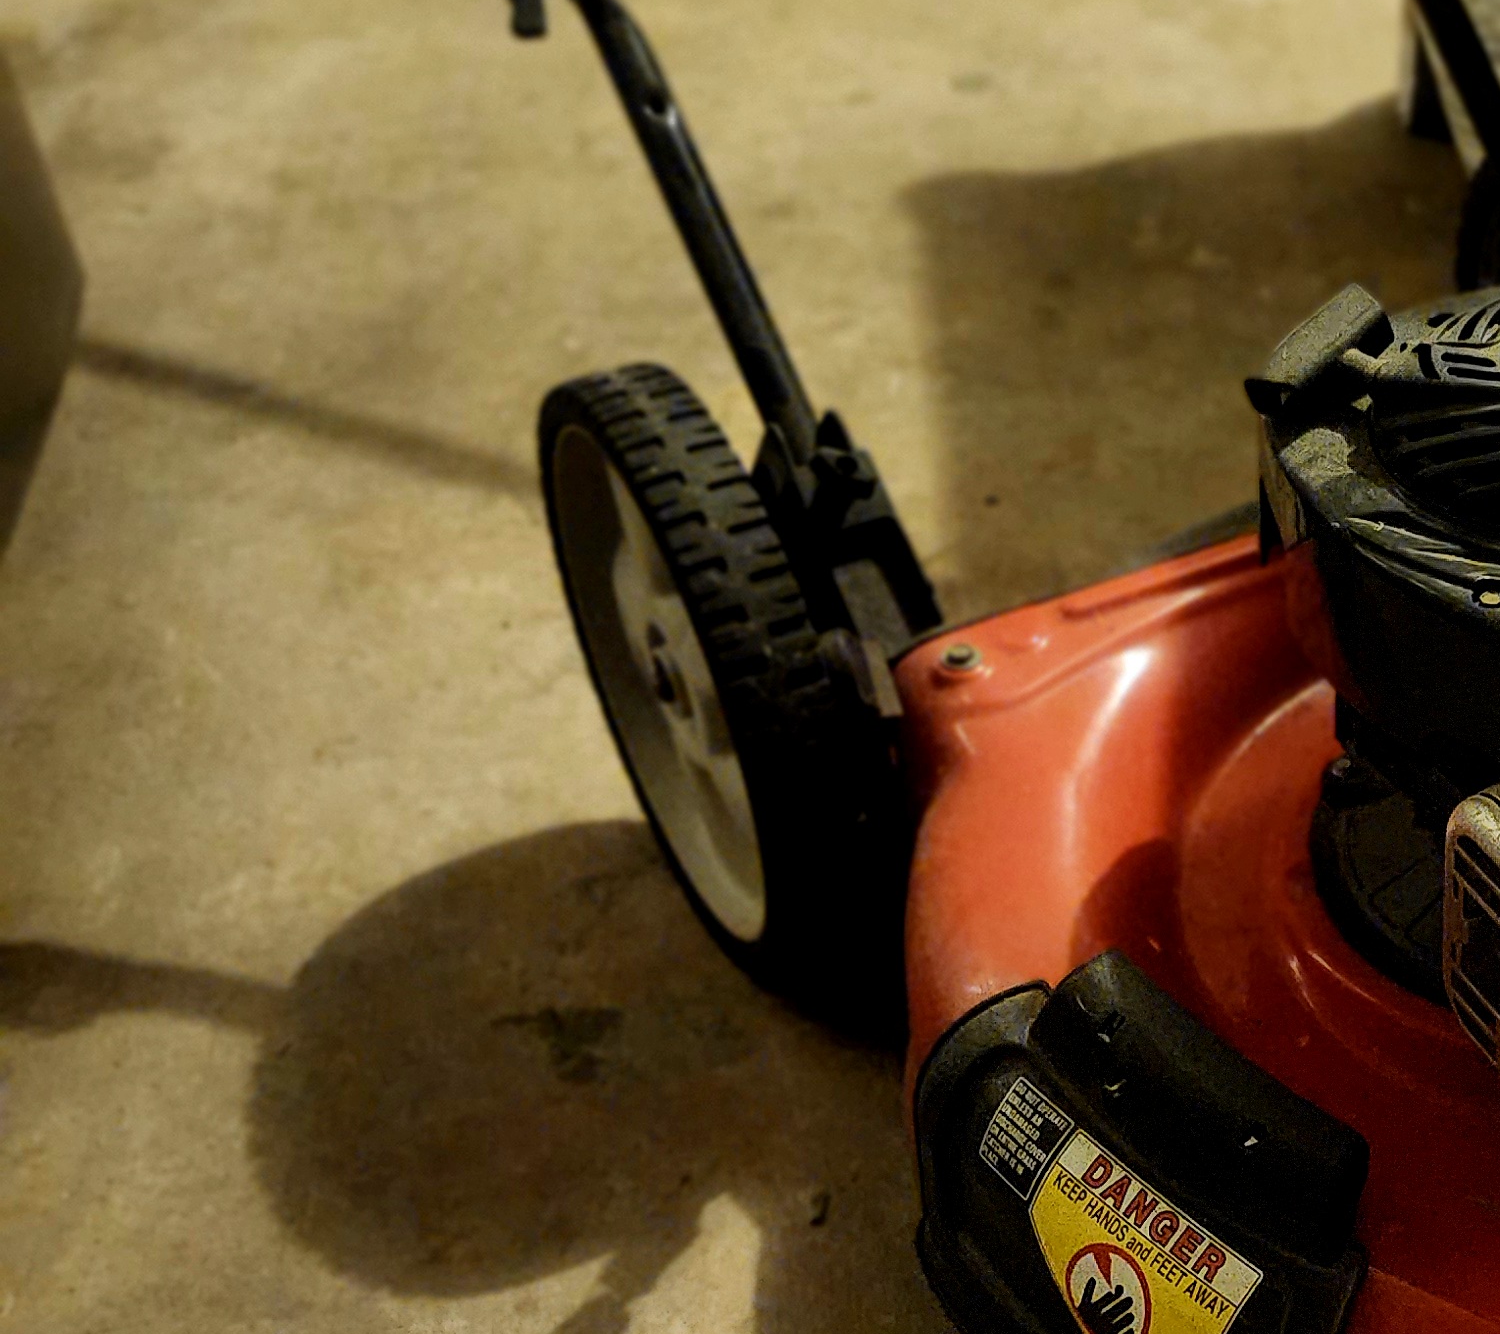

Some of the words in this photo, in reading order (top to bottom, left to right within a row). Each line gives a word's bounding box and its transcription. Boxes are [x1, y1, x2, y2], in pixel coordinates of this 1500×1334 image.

[1053, 1169, 1088, 1212] KEEP
[1084, 1199, 1129, 1244] HANDS
[1126, 1235, 1151, 1261] and
[1149, 1253, 1188, 1289] FEET
[1185, 1282, 1229, 1320] AWAY
[1081, 1154, 1228, 1285] DANGER
